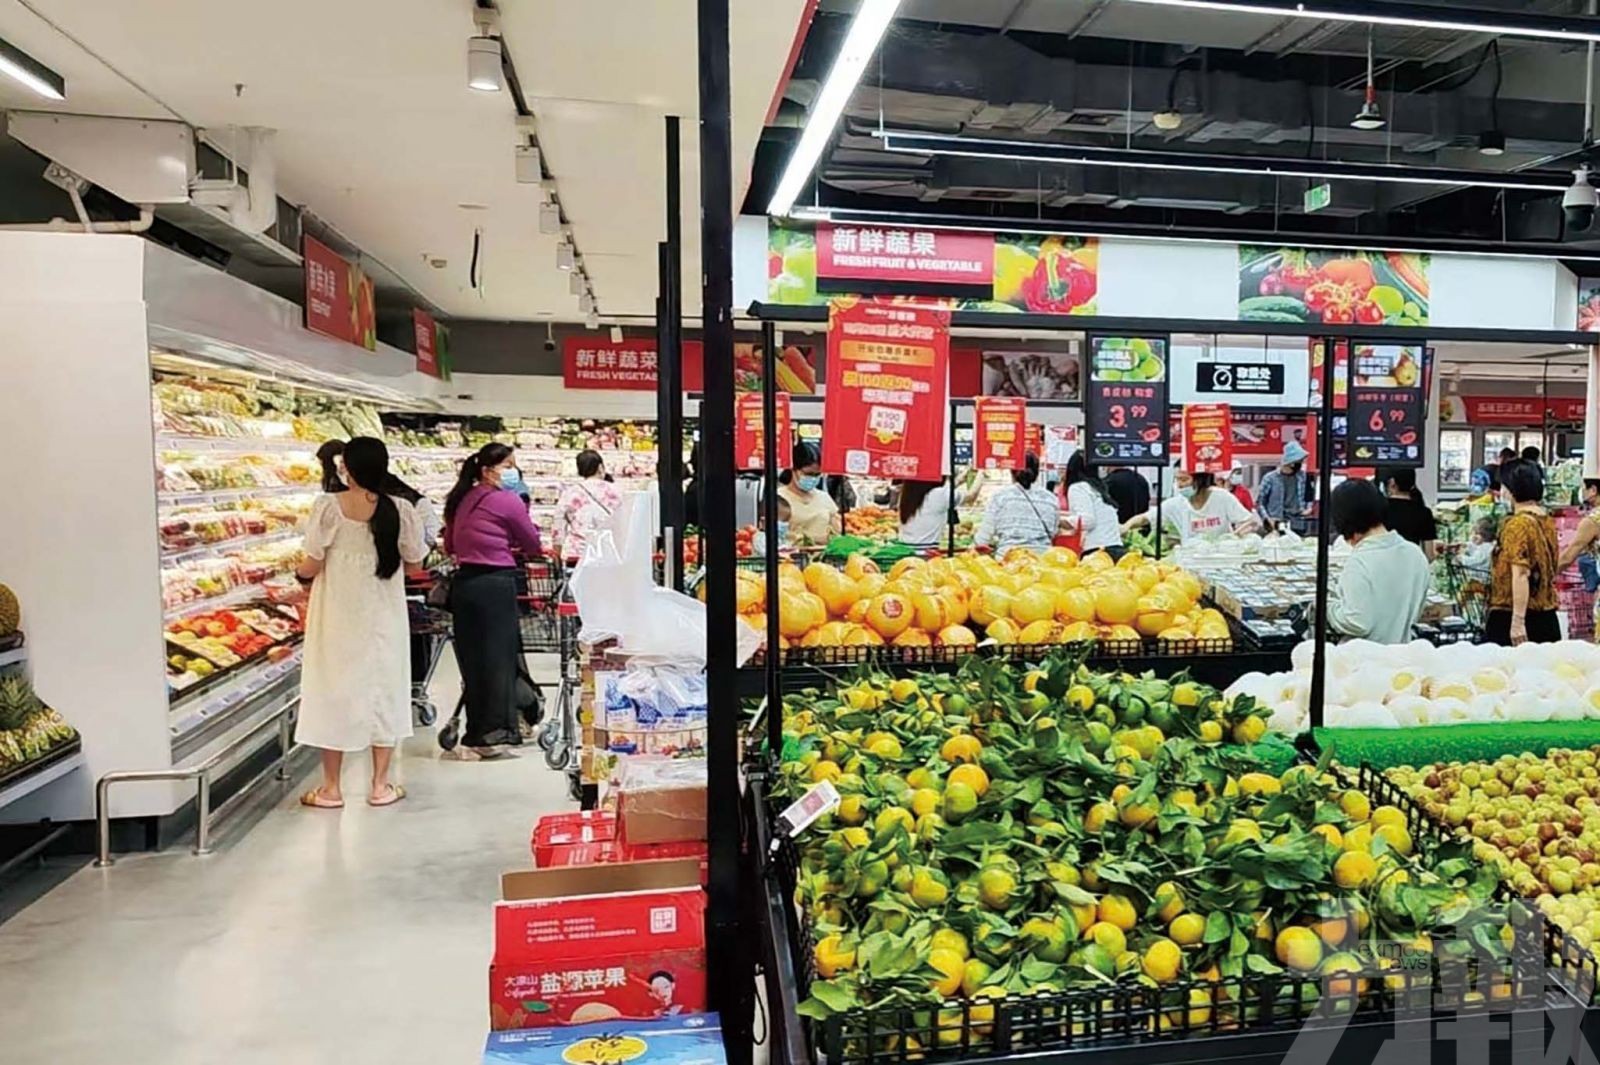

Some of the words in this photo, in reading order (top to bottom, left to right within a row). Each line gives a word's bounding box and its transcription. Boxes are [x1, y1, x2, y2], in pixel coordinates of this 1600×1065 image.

[832, 227, 936, 256] 新鲜蔬果
[832, 254, 870, 267] FRESH
[872, 256, 906, 269] FRUIT
[907, 258, 916, 270] &
[917, 258, 982, 273] VEGETABLE
[576, 348, 658, 370] 新鲜蔬菜
[576, 370, 610, 380] FRESH
[540, 966, 627, 994] 盐源苹果
